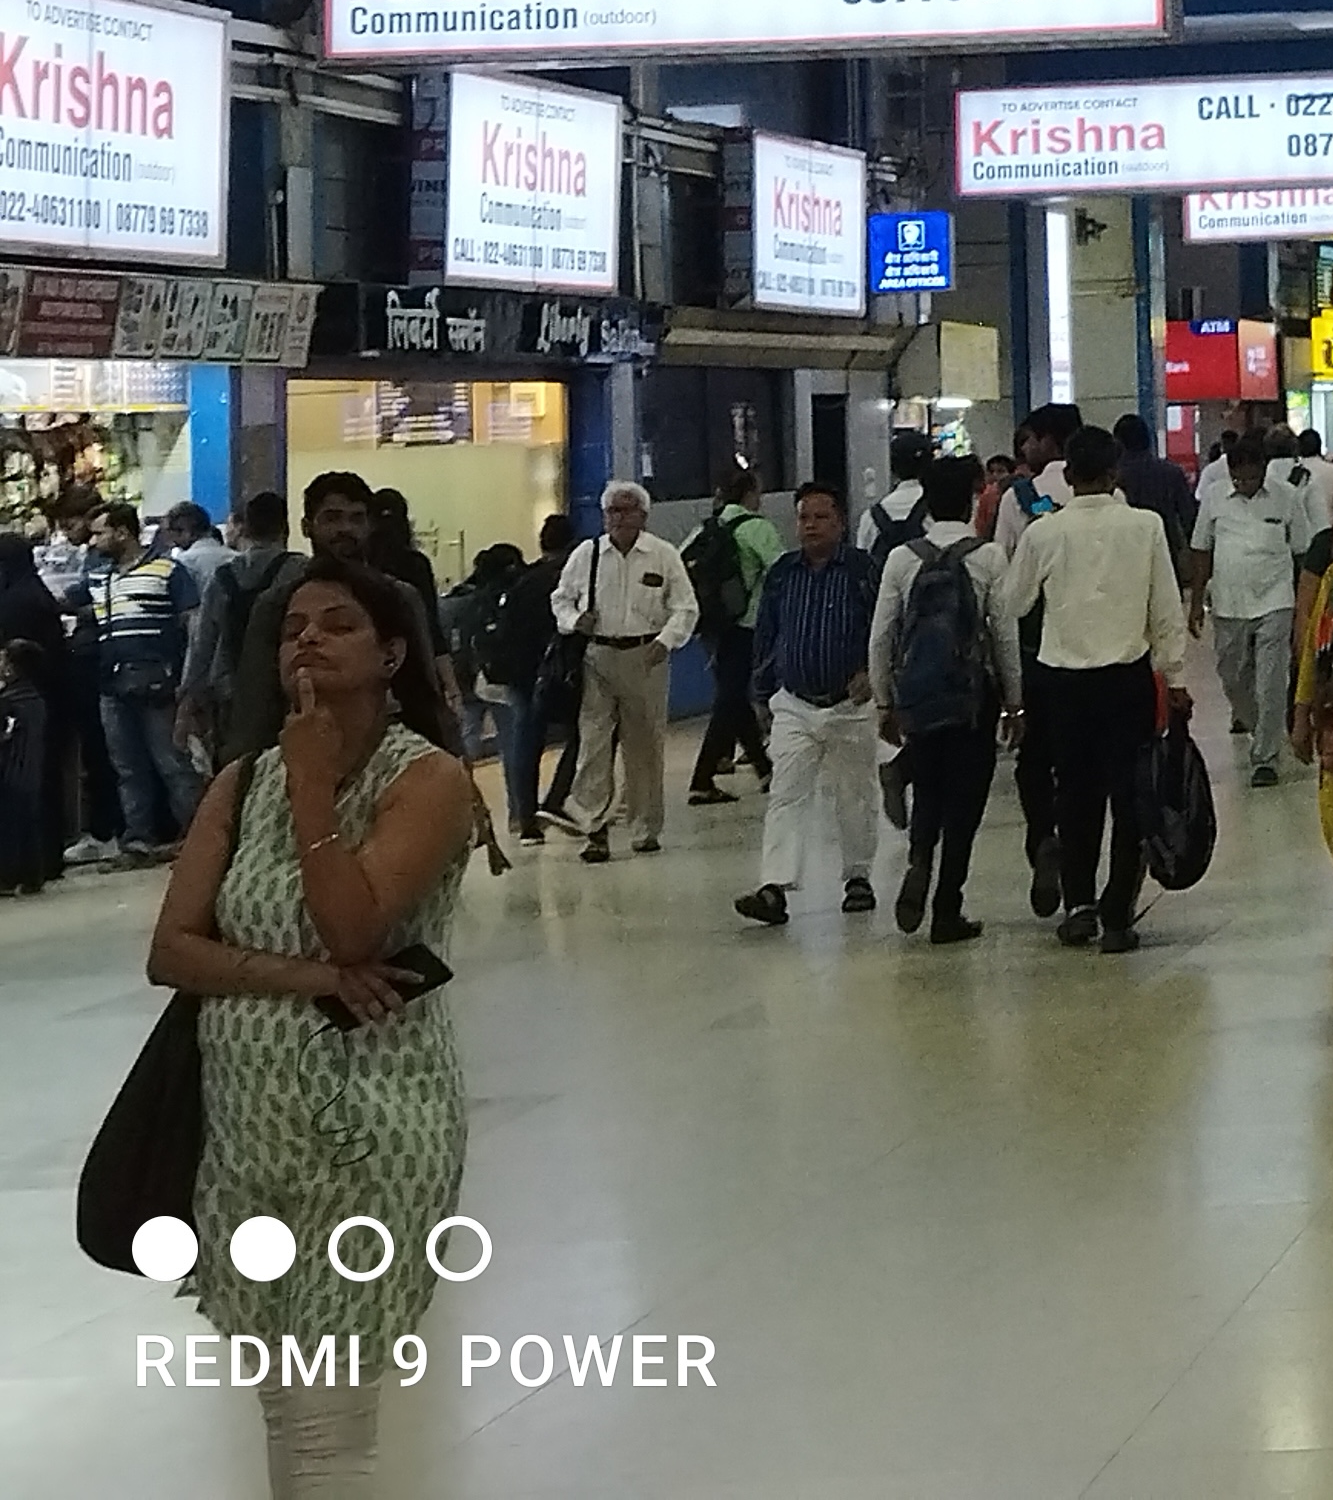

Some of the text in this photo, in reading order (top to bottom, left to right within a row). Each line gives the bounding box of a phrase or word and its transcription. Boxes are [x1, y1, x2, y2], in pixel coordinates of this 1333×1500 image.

[351, 3, 657, 34] Communication (outdoor)
[0, 31, 174, 140] Krishna
[1198, 95, 1260, 120] CALL
[972, 117, 1166, 157] Krishna
[481, 120, 587, 198] Krishna
[973, 157, 1118, 180] Communication
[774, 176, 842, 237] Krishna
[1199, 211, 1308, 229] Communication
[1200, 321, 1230, 334] ATM
